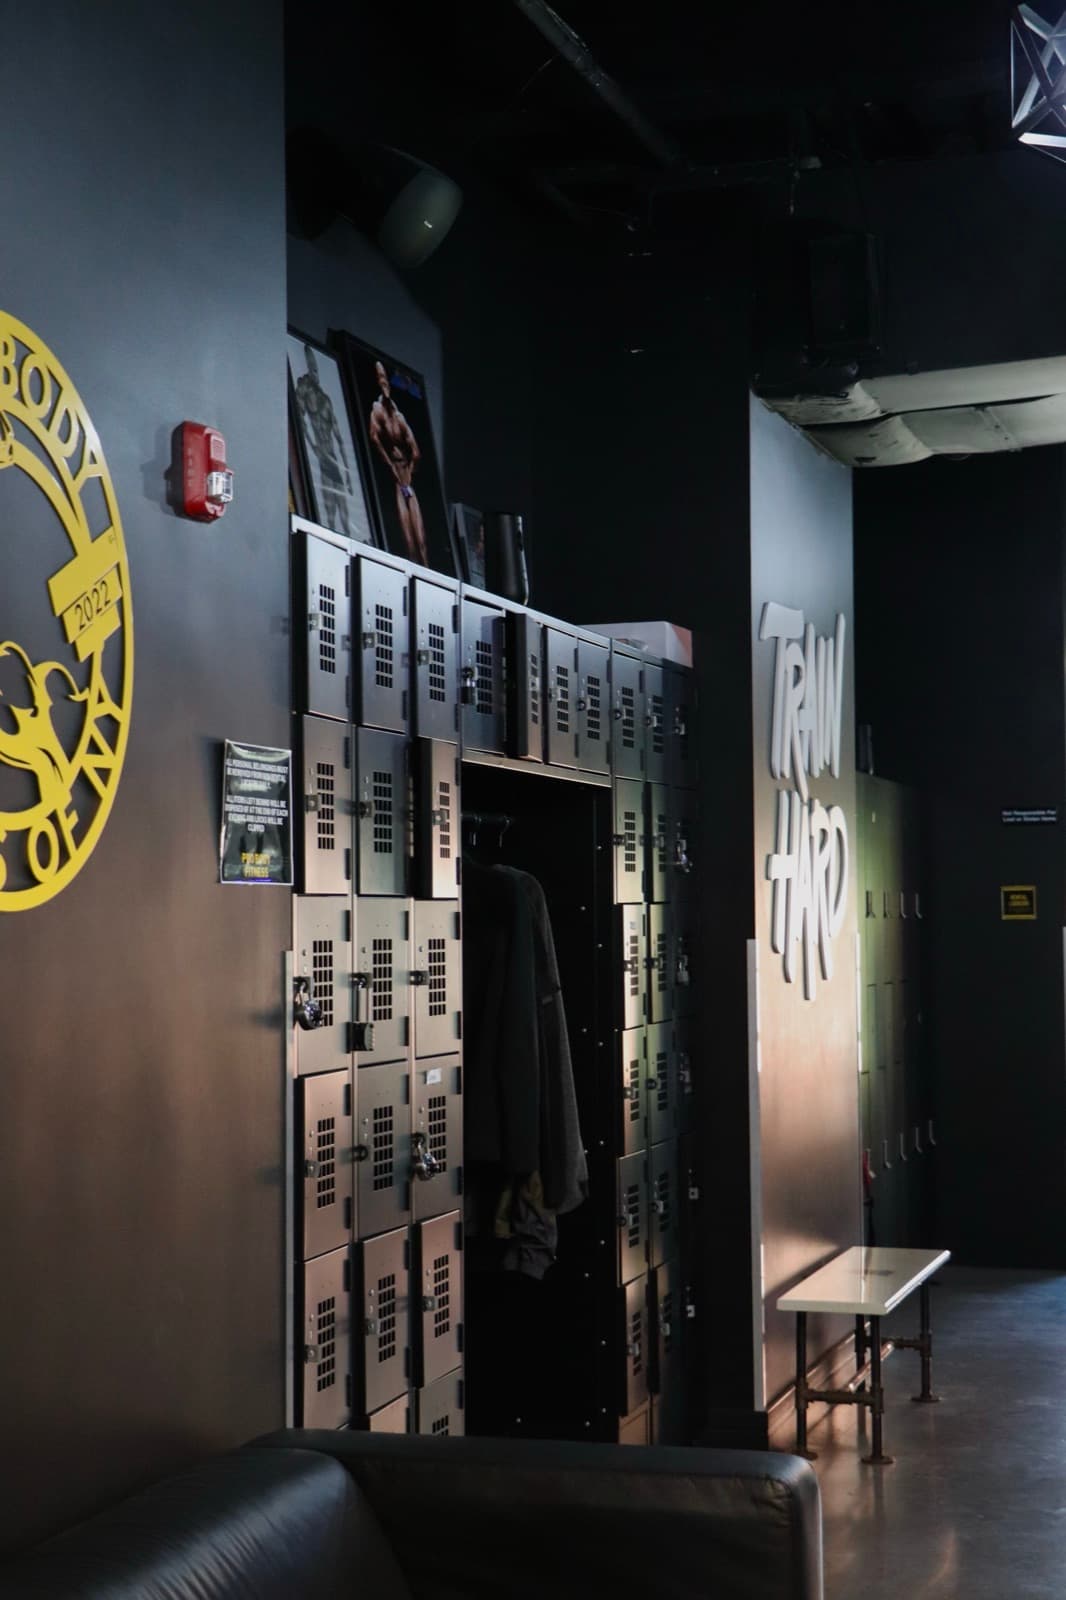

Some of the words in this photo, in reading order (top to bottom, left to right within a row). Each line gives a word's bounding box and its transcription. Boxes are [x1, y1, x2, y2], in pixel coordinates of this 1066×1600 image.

[75, 579, 111, 631] 2022
[759, 600, 846, 802] TRAIN
[765, 789, 850, 1001] HARD
